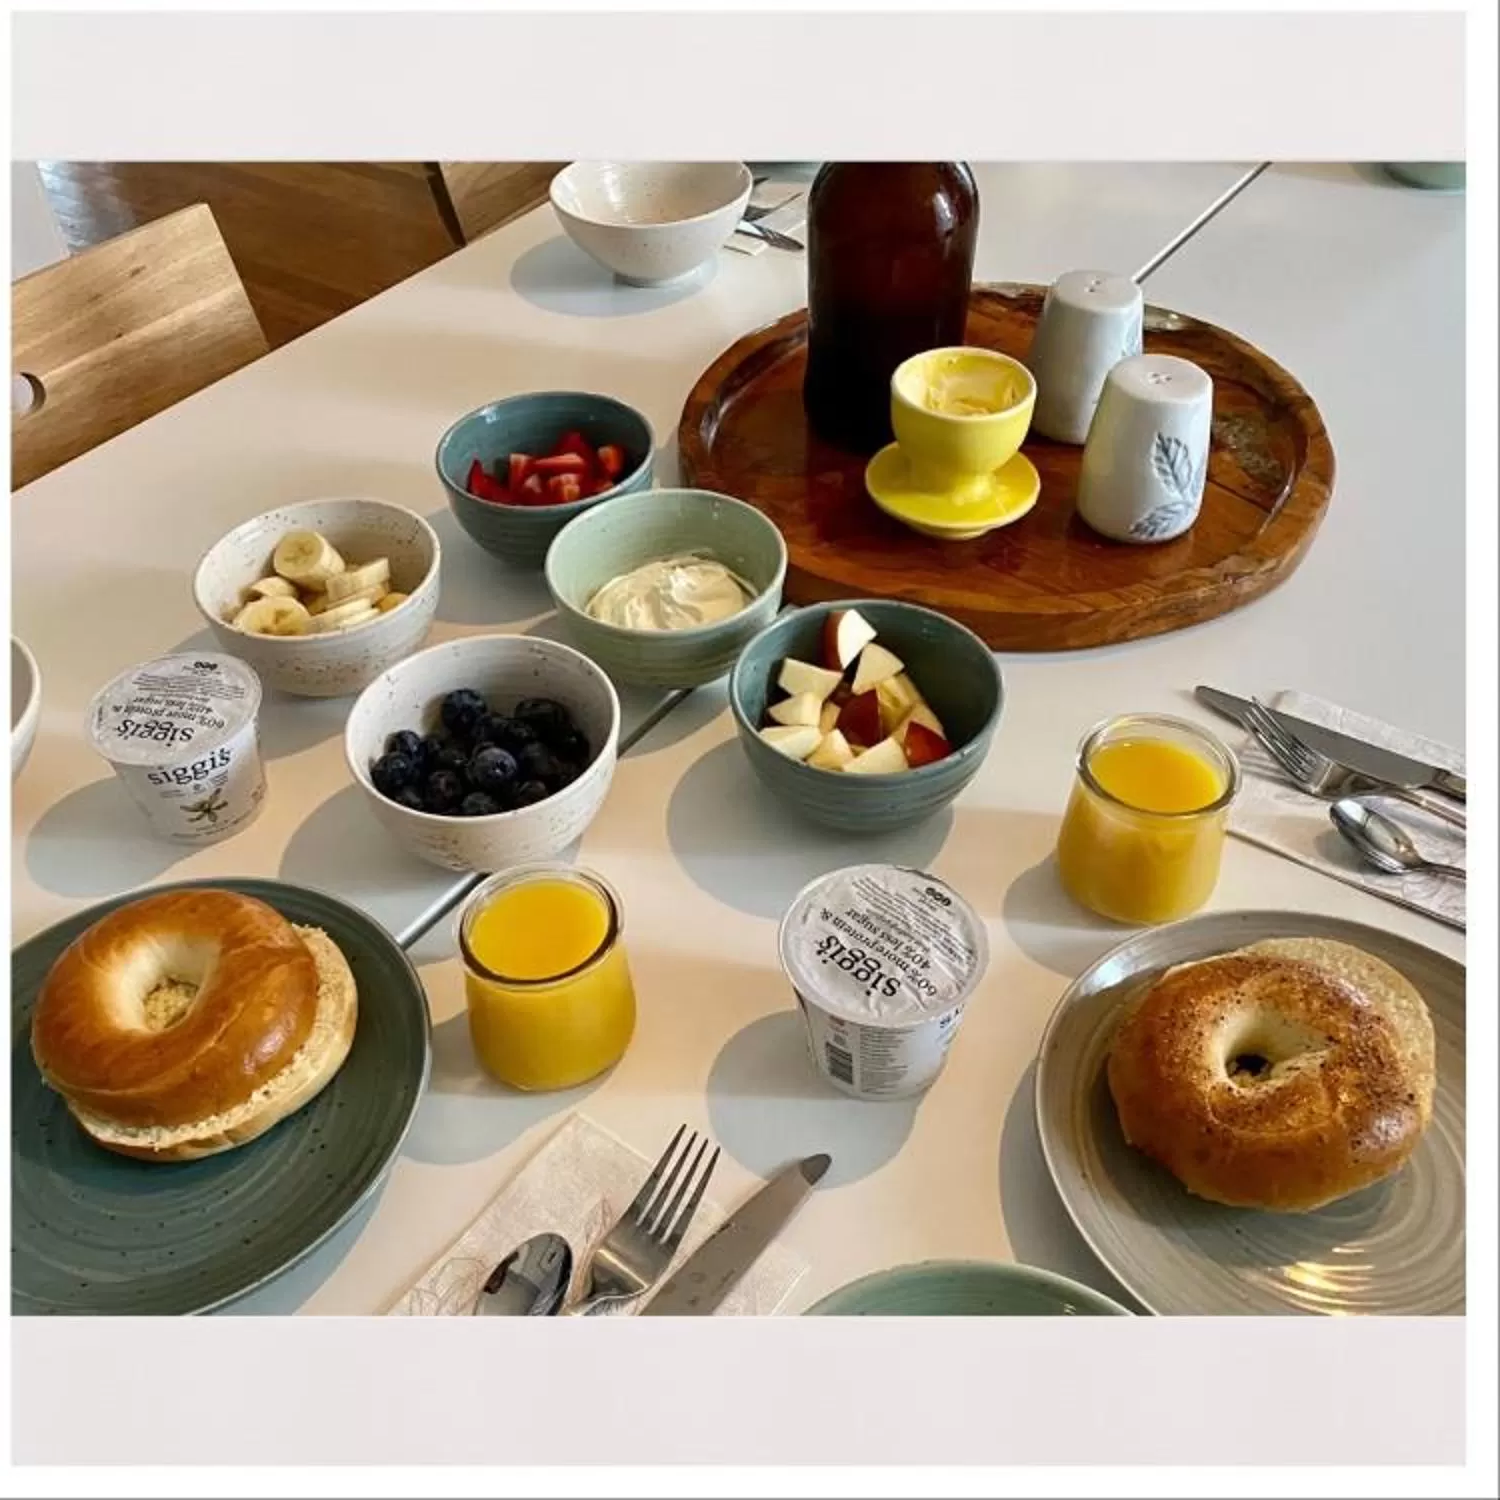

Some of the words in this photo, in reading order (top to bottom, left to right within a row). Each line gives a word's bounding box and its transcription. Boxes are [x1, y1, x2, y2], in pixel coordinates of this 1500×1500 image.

[832, 916, 880, 950] protein
[844, 907, 879, 936] sugar
[875, 943, 910, 973] more
[901, 944, 932, 970] 40%
[906, 967, 938, 997] 60%
